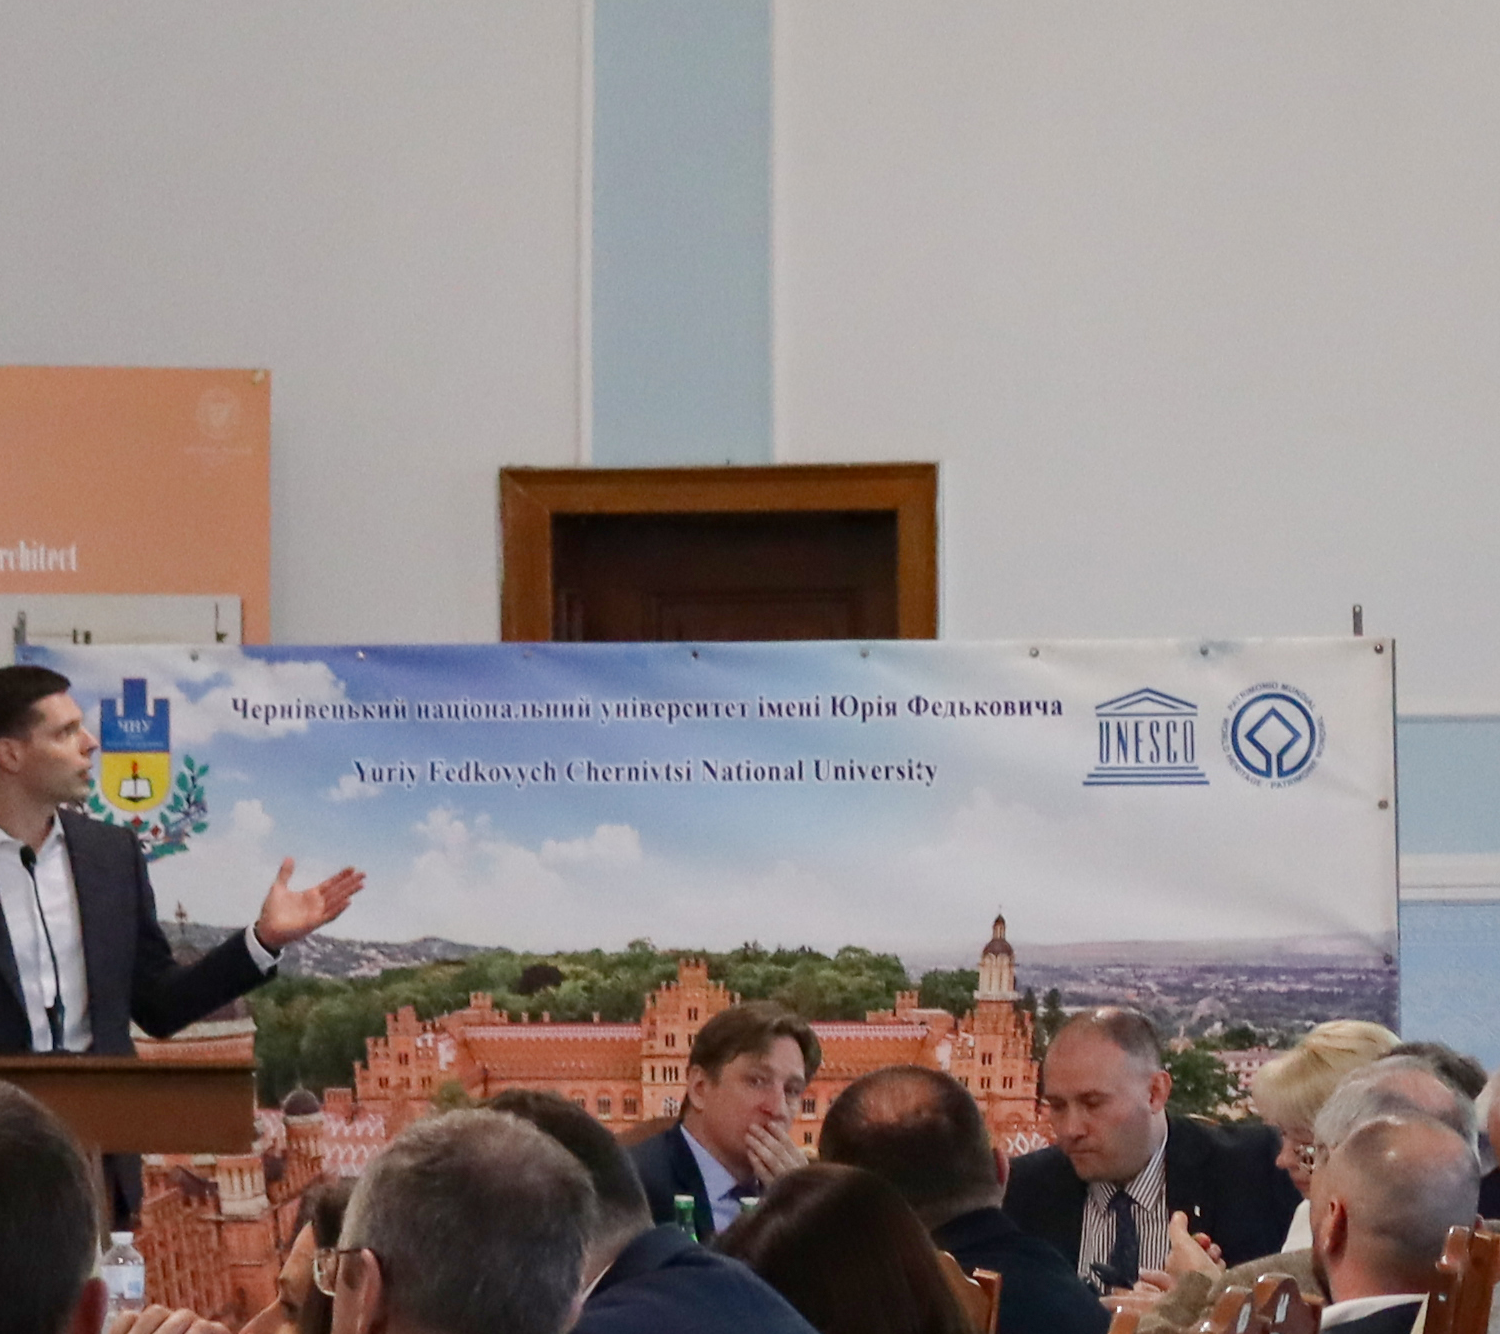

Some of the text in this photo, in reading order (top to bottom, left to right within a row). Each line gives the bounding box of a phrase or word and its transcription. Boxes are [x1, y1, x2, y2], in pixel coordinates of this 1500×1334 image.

[231, 695, 1063, 724] Чернівецький національний університет імені Юрія Федьковича
[1100, 720, 1195, 764] UNESCO
[355, 760, 938, 790] Yuriy Fedkovych Chernivtsi National University
